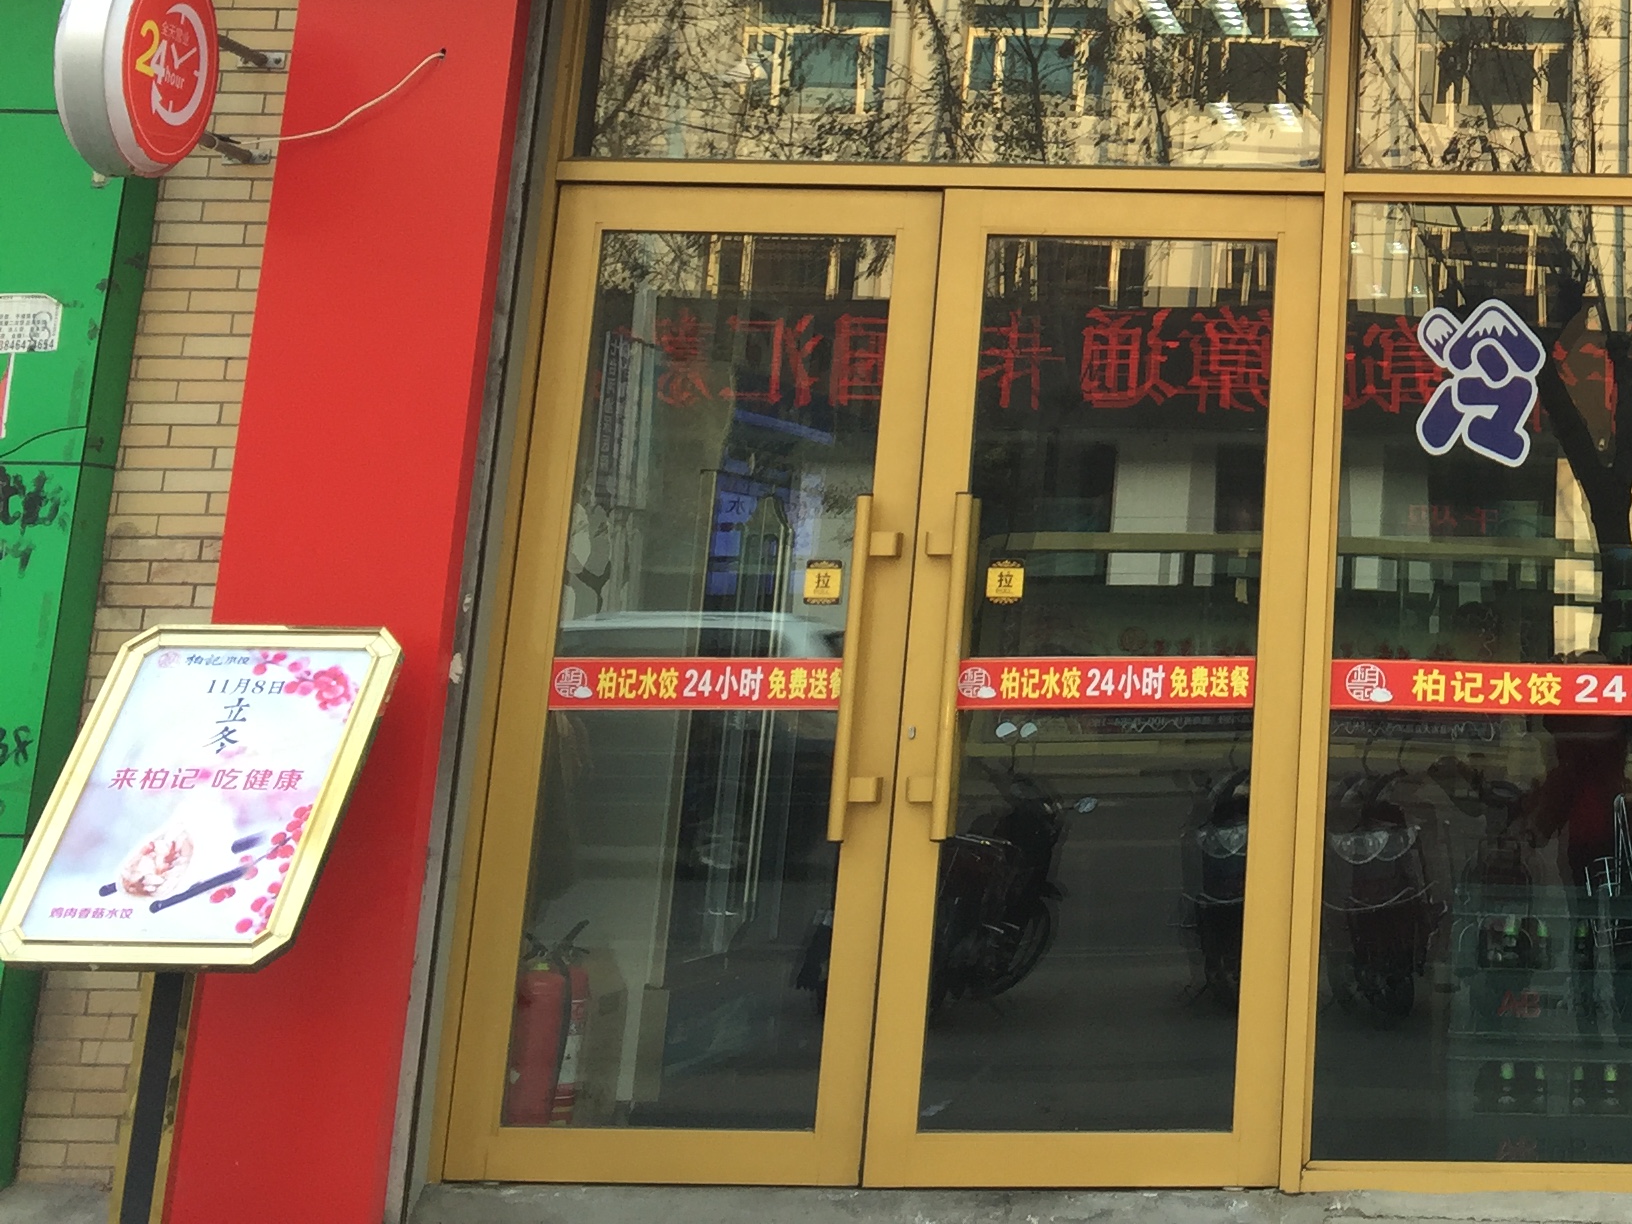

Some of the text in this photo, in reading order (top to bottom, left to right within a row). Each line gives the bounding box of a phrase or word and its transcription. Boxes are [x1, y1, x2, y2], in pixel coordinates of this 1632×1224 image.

[135, 19, 168, 86] 24
[207, 677, 286, 695] 11月8日
[202, 697, 251, 755] 立冬
